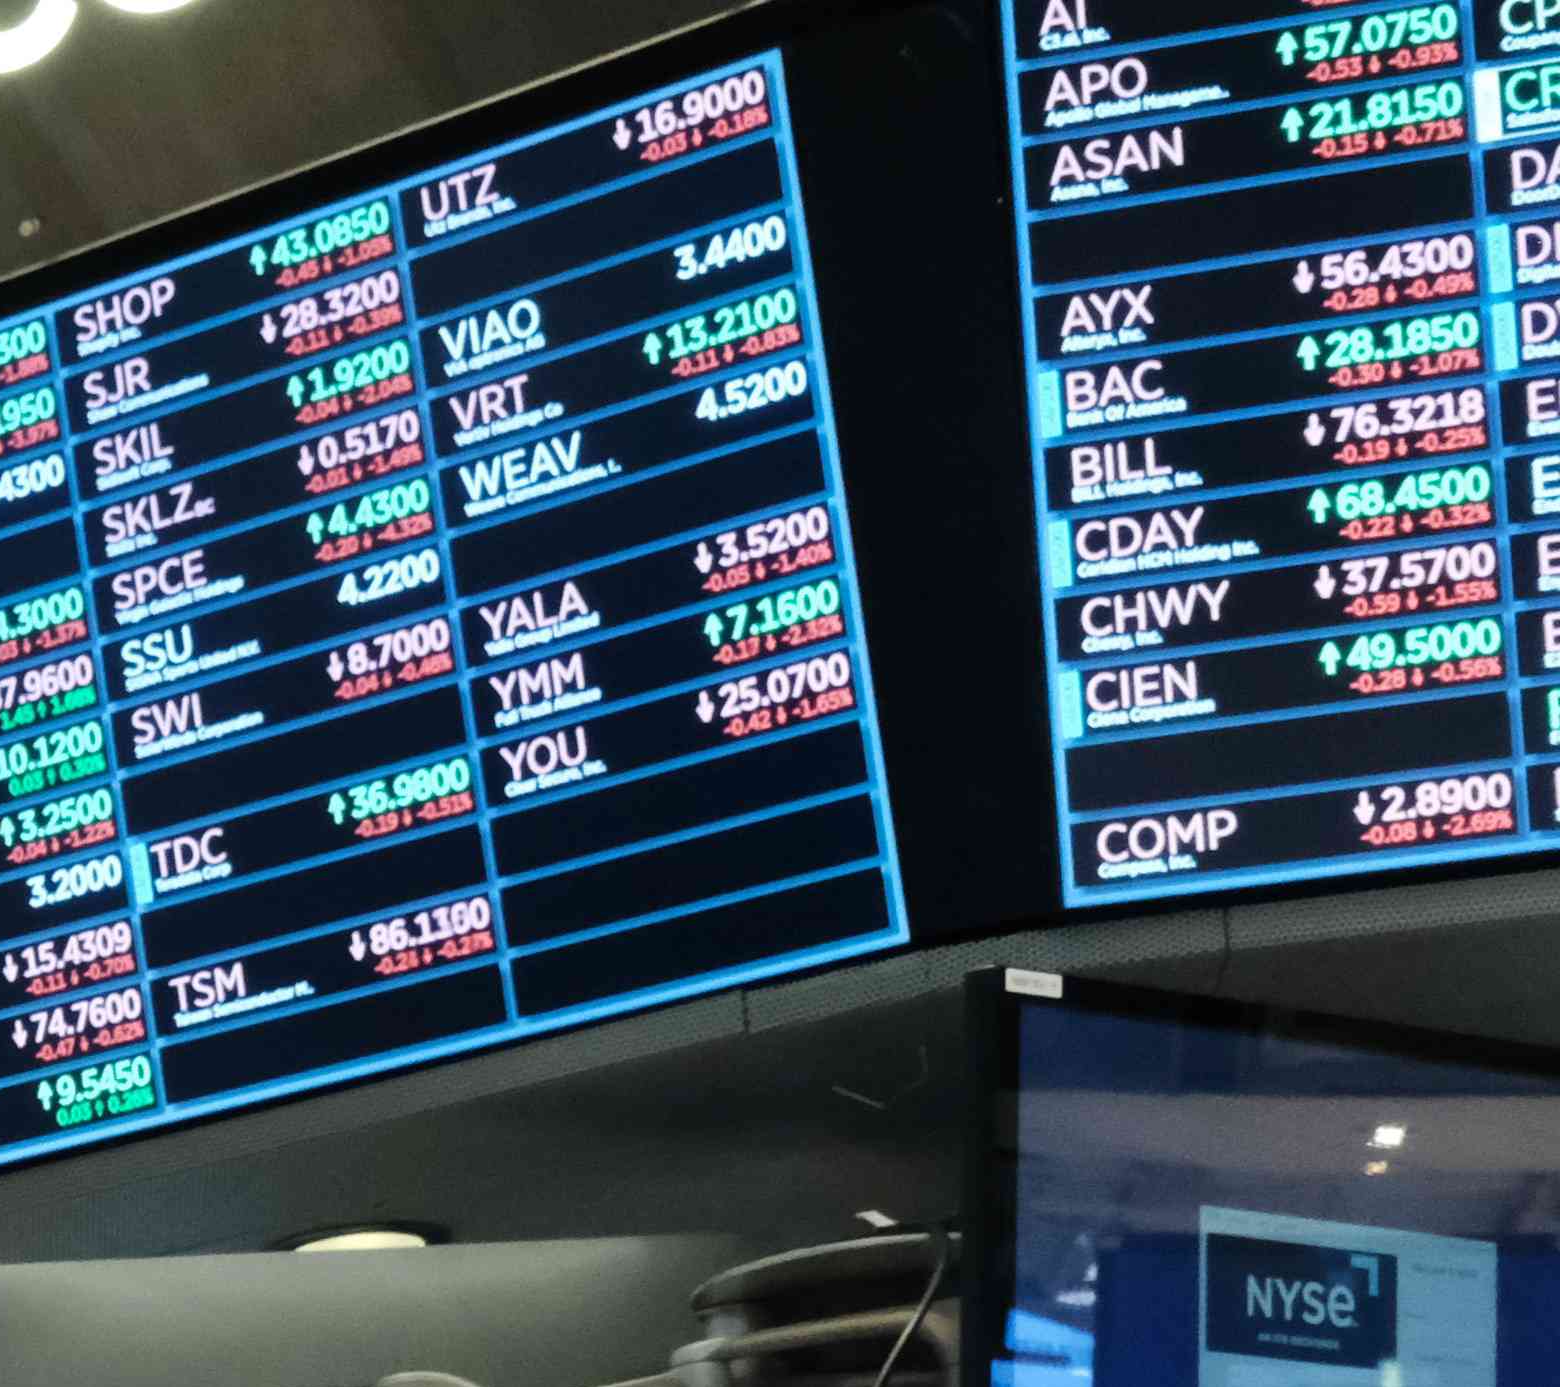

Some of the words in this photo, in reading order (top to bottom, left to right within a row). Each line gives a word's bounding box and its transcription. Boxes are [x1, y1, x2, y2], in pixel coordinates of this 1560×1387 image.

[1304, 5, 1457, 61] 57.0750
[637, 71, 765, 144] 16.9000
[1044, 58, 1148, 112] APO
[1308, 83, 1462, 139] 21.8150
[1049, 127, 1185, 186] ASAN
[421, 163, 499, 223] UTZ
[271, 202, 390, 267] 43.0850
[674, 216, 786, 280] 3.4400
[1320, 235, 1474, 290] 56.4300
[74, 278, 176, 342] SHOP
[281, 271, 400, 338] 28.3200
[439, 298, 540, 360] VIAO
[666, 289, 796, 359] 13.2100
[1061, 286, 1155, 337] AYX
[1325, 314, 1479, 368] 28.1850
[82, 357, 152, 409] SJR
[309, 341, 410, 400] 1.9200
[695, 362, 807, 423] 4.5200
[1065, 361, 1165, 413] BAC
[449, 376, 528, 431] VRT
[1330, 389, 1485, 440] 76.3218
[93, 423, 174, 476] SKIL
[460, 433, 583, 499] WEAV
[1070, 439, 1174, 489] BILL
[1335, 466, 1490, 519] 68.4500
[718, 507, 828, 566] 3.5200
[1075, 507, 1205, 564] CDAY
[111, 551, 208, 612] SPCE
[1341, 543, 1496, 594] 37.5700
[480, 583, 589, 640] YALA
[727, 582, 839, 640] 7.1600
[1081, 580, 1231, 638] CHWY
[121, 625, 194, 676] SSU
[1346, 620, 1501, 670] 49.5000
[490, 655, 586, 707] YMM
[719, 652, 850, 716] 25.0700
[1085, 660, 1199, 714] CIEN
[130, 697, 205, 746] SWI
[500, 727, 588, 781] YOU
[1381, 773, 1511, 823] 2.8900
[150, 829, 228, 879] TDC
[1096, 810, 1238, 865] COMP
[26, 857, 122, 908] 3.2000
[21, 923, 132, 979] 15.4309
[169, 963, 247, 1015] TSM
[55, 1057, 151, 1107] 9.5450
